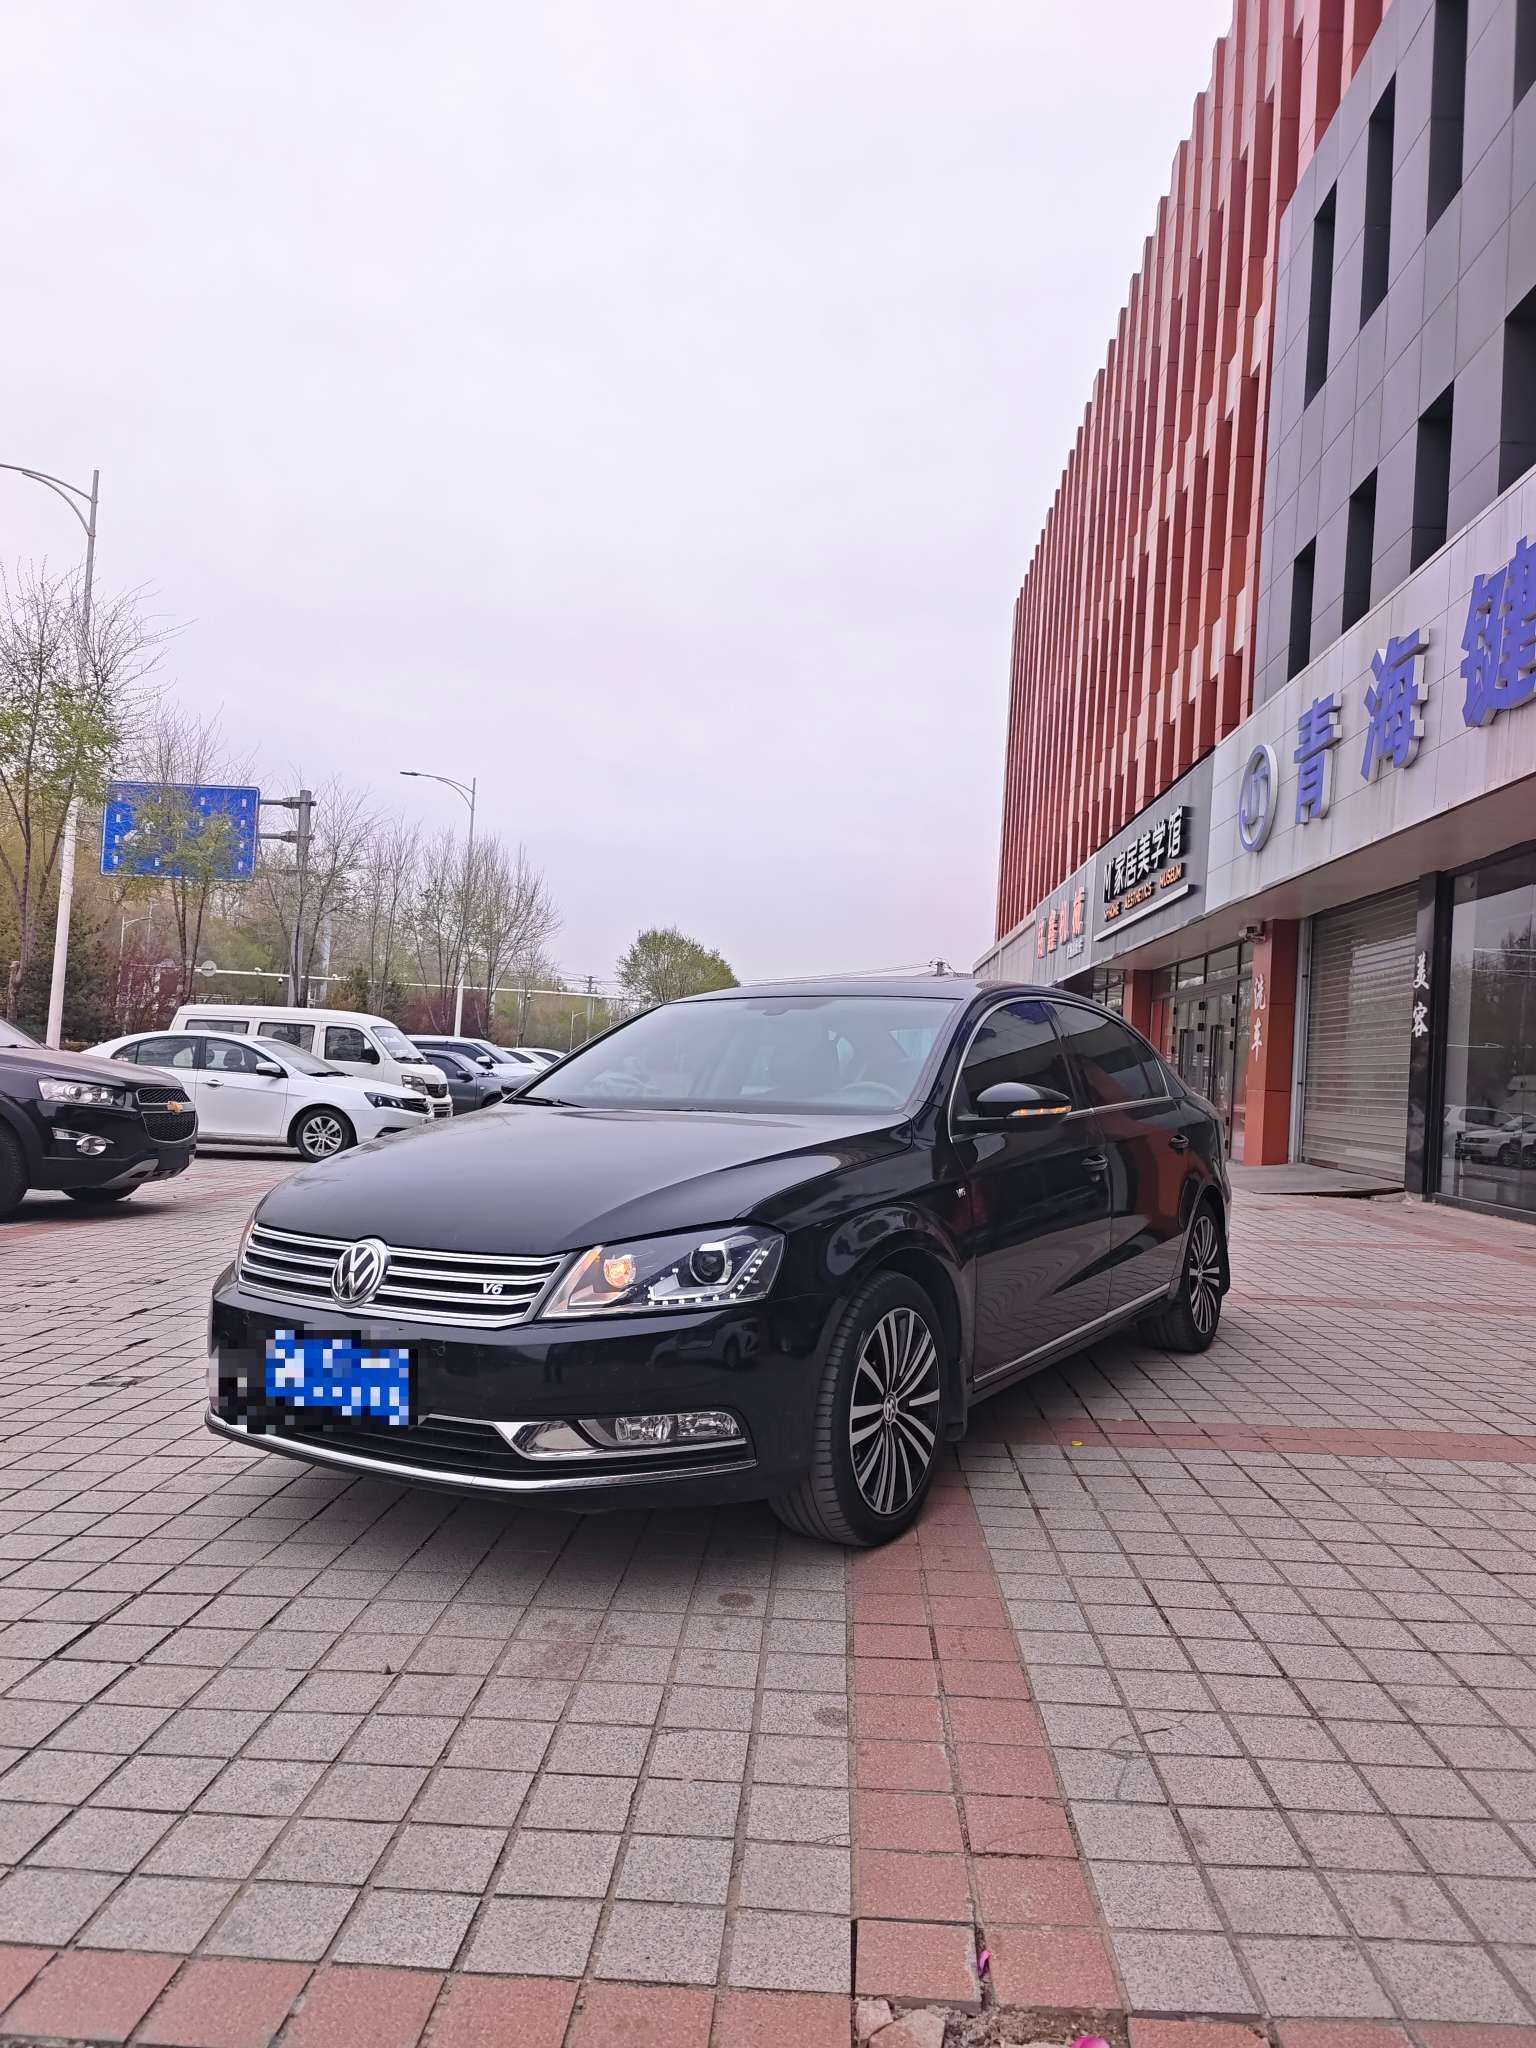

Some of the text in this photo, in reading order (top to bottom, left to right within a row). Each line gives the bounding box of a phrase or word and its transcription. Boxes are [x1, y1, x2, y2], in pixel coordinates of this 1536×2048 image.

[1159, 863, 1182, 888] MUSEUM
[1251, 974, 1266, 1062] 洗车
[1412, 951, 1430, 1038] 美容
[482, 1282, 503, 1295] V6
